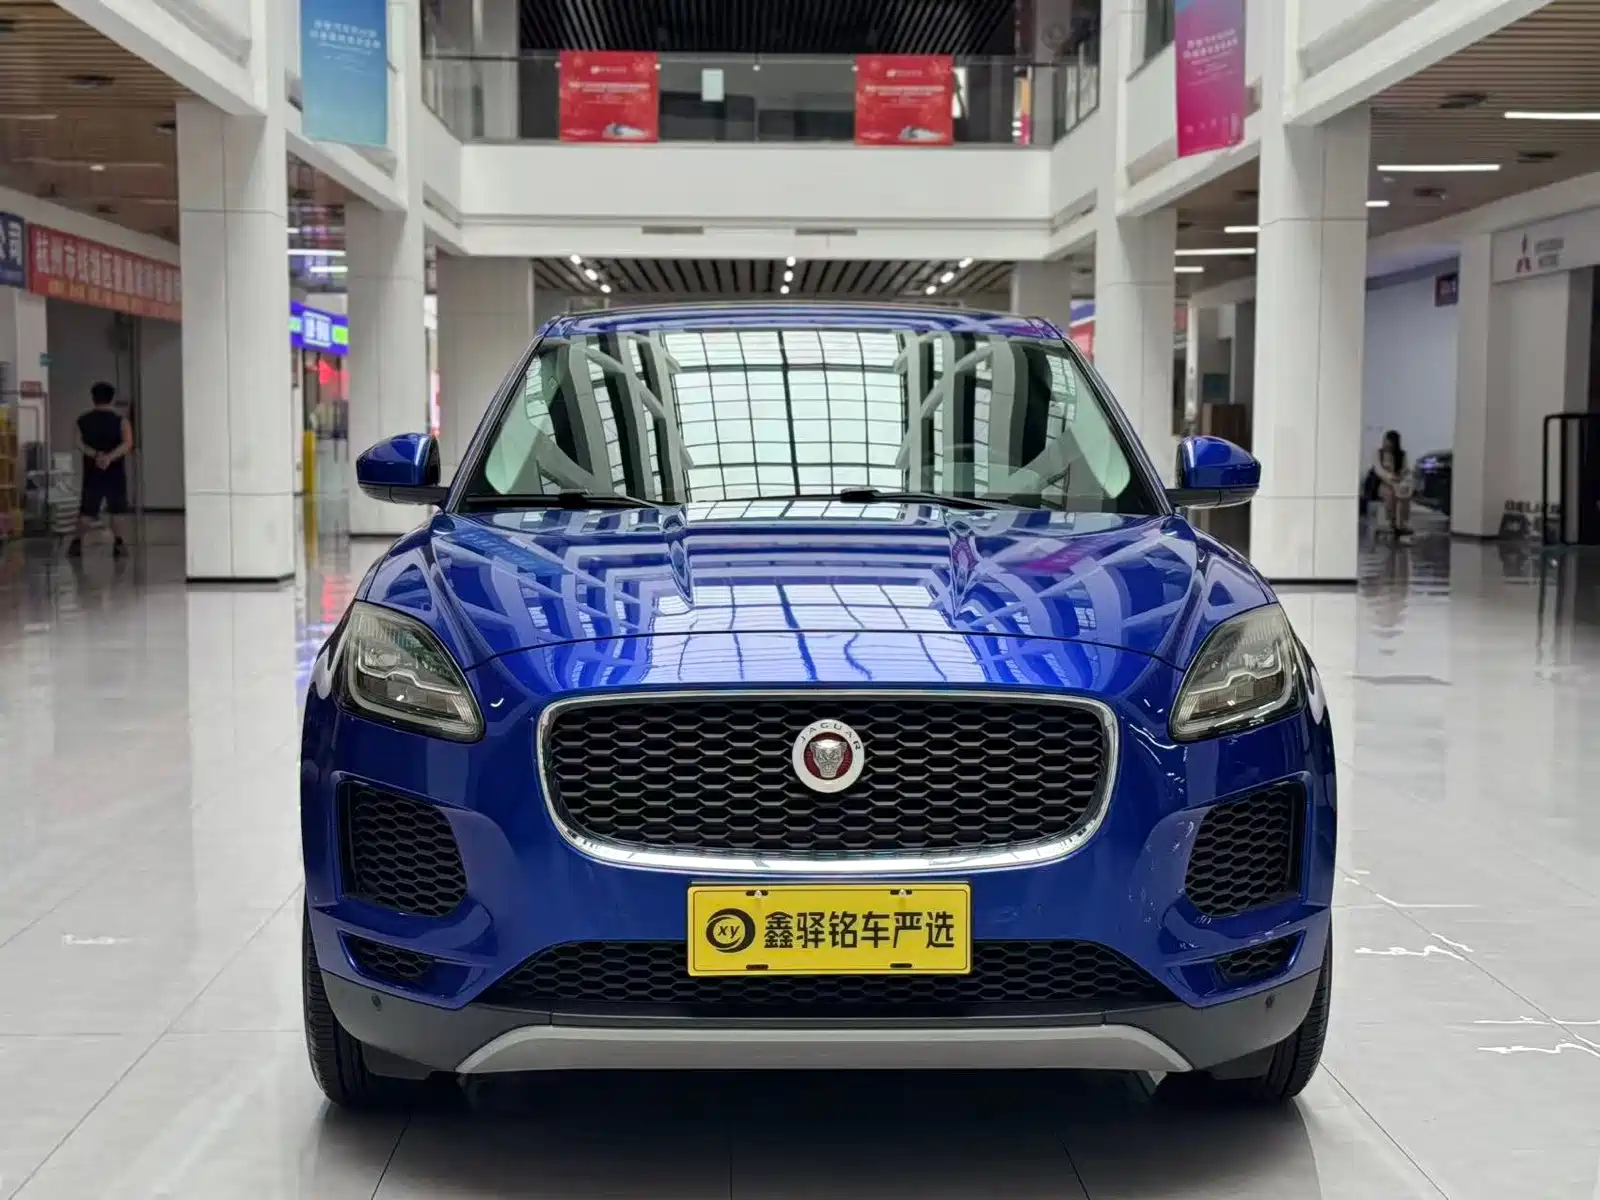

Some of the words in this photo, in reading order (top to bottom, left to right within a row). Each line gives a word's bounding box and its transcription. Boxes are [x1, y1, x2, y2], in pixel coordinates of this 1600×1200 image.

[801, 722, 861, 751] JAGUAR
[764, 911, 955, 949] 鑫驿铭车严选
